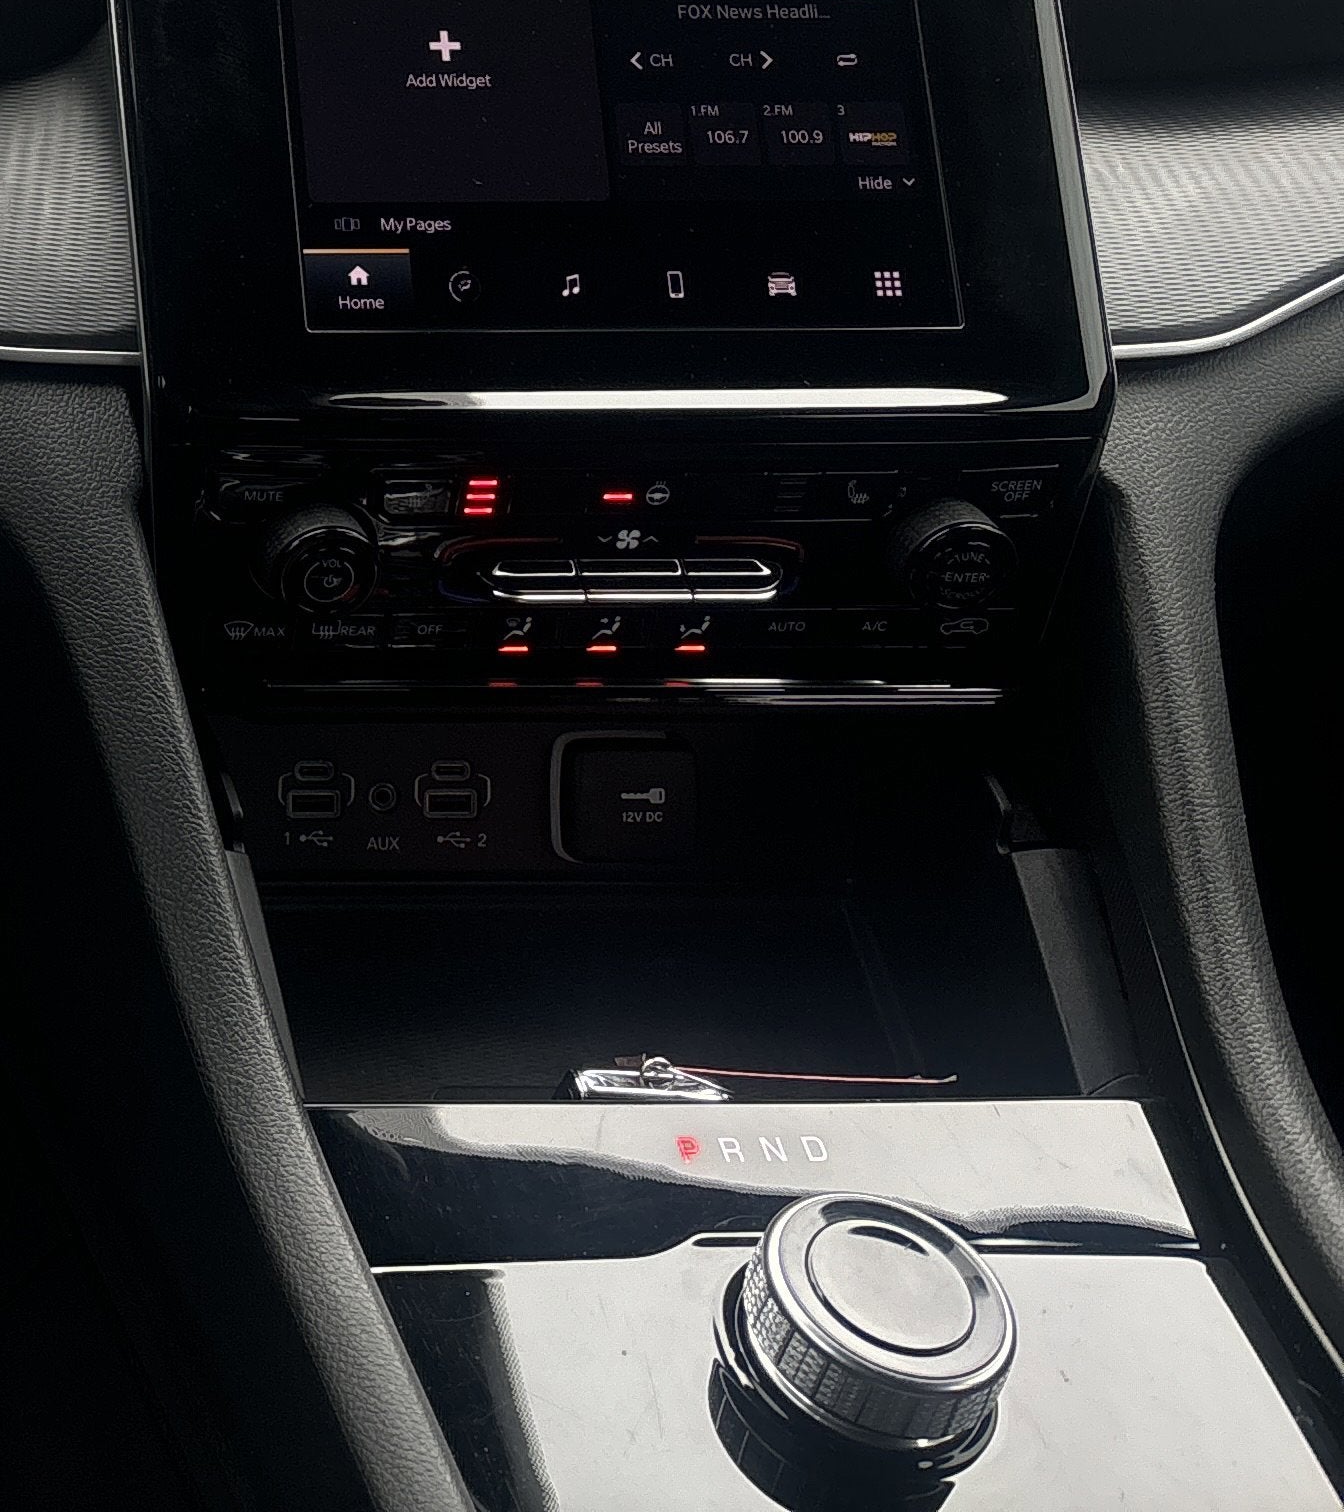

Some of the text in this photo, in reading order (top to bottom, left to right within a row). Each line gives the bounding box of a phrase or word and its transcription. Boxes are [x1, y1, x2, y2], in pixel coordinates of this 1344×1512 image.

[677, 4, 712, 19] FOX
[717, 4, 762, 19] News
[649, 54, 753, 67] CH CH
[406, 74, 492, 90] Add Widget
[837, 104, 845, 116] 3
[644, 121, 662, 135] All
[707, 130, 749, 144] 106.7
[780, 130, 823, 144] 100.9
[628, 139, 683, 154] Presets
[858, 176, 893, 189] Hide
[380, 218, 452, 234] My Pages
[338, 295, 385, 310] Home
[991, 479, 1043, 492] SCREEN
[243, 490, 284, 502] MUTE
[1004, 491, 1031, 503] OFF
[322, 559, 343, 569] VOL
[945, 572, 987, 583] ENTER
[253, 625, 286, 637] MAX
[340, 624, 376, 636] REAR
[417, 624, 443, 636] OFF
[767, 621, 806, 632] AUTO
[861, 620, 888, 632] A/C
[622, 811, 663, 823] 12V DC
[284, 832, 290, 845] 1
[367, 837, 400, 851] AUX
[478, 834, 487, 847] 2
[676, 1134, 828, 1164] P R N D
